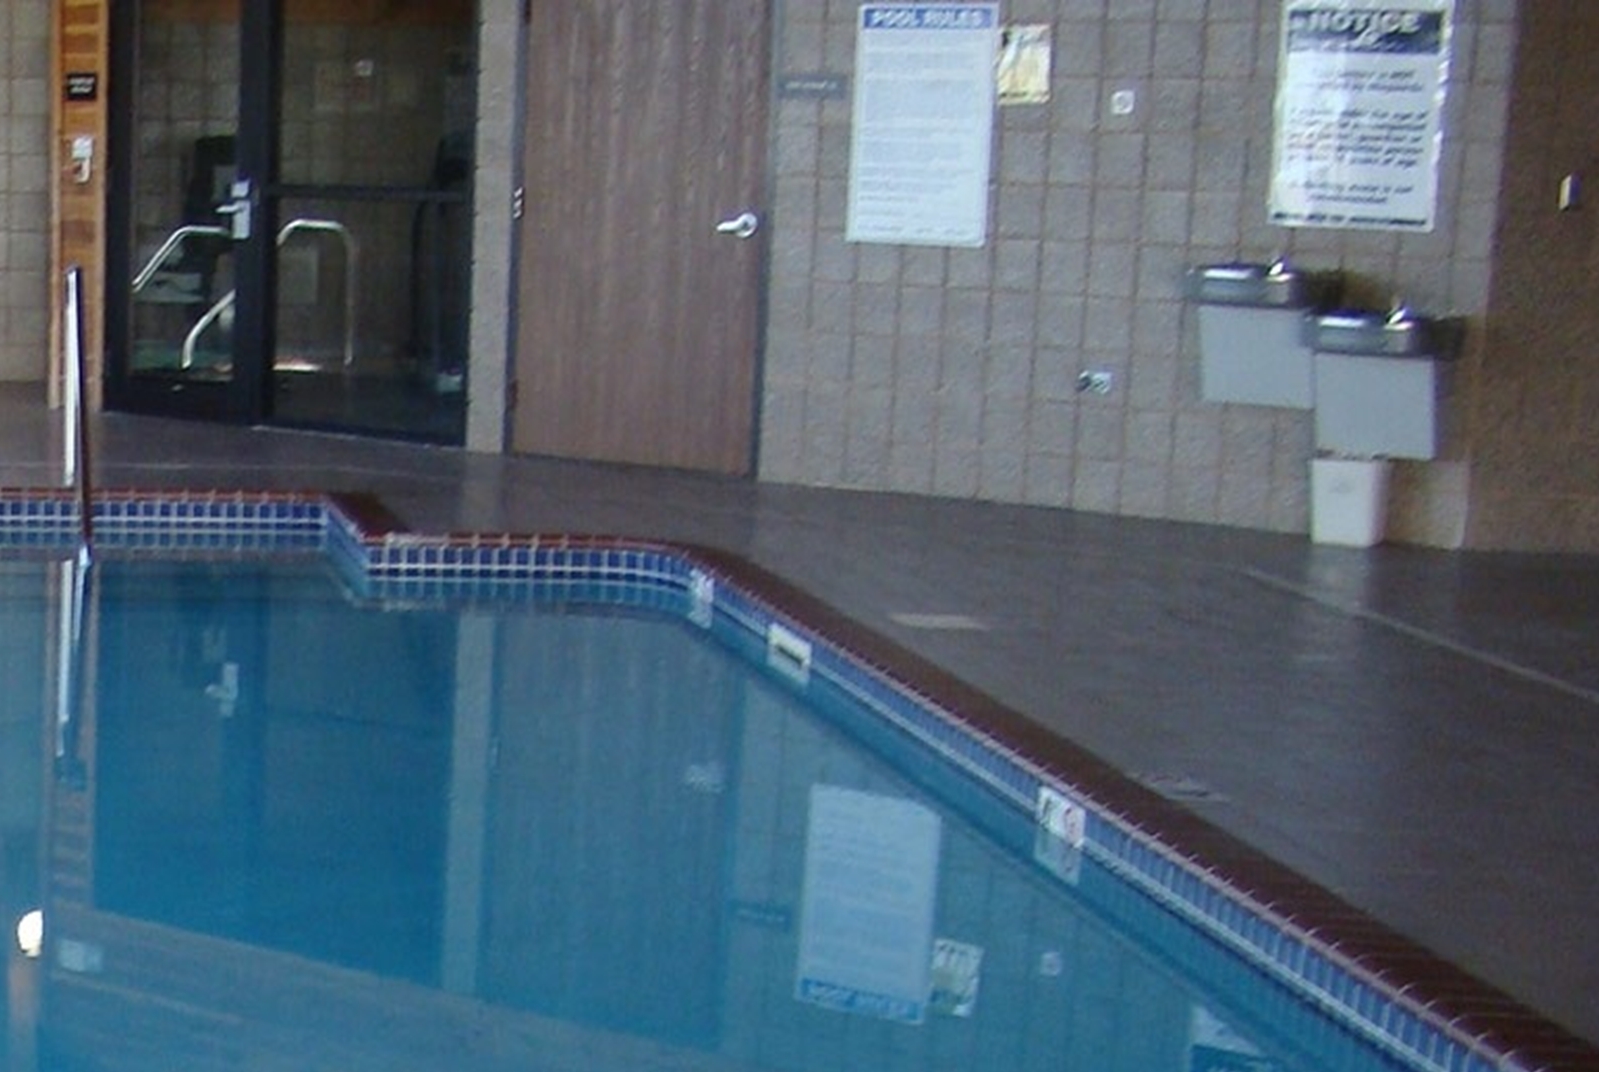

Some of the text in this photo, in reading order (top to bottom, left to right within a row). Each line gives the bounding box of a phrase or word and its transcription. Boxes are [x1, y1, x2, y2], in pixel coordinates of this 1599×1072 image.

[871, 9, 985, 28] POOL RULES
[1307, 11, 1421, 34] NOTICE
